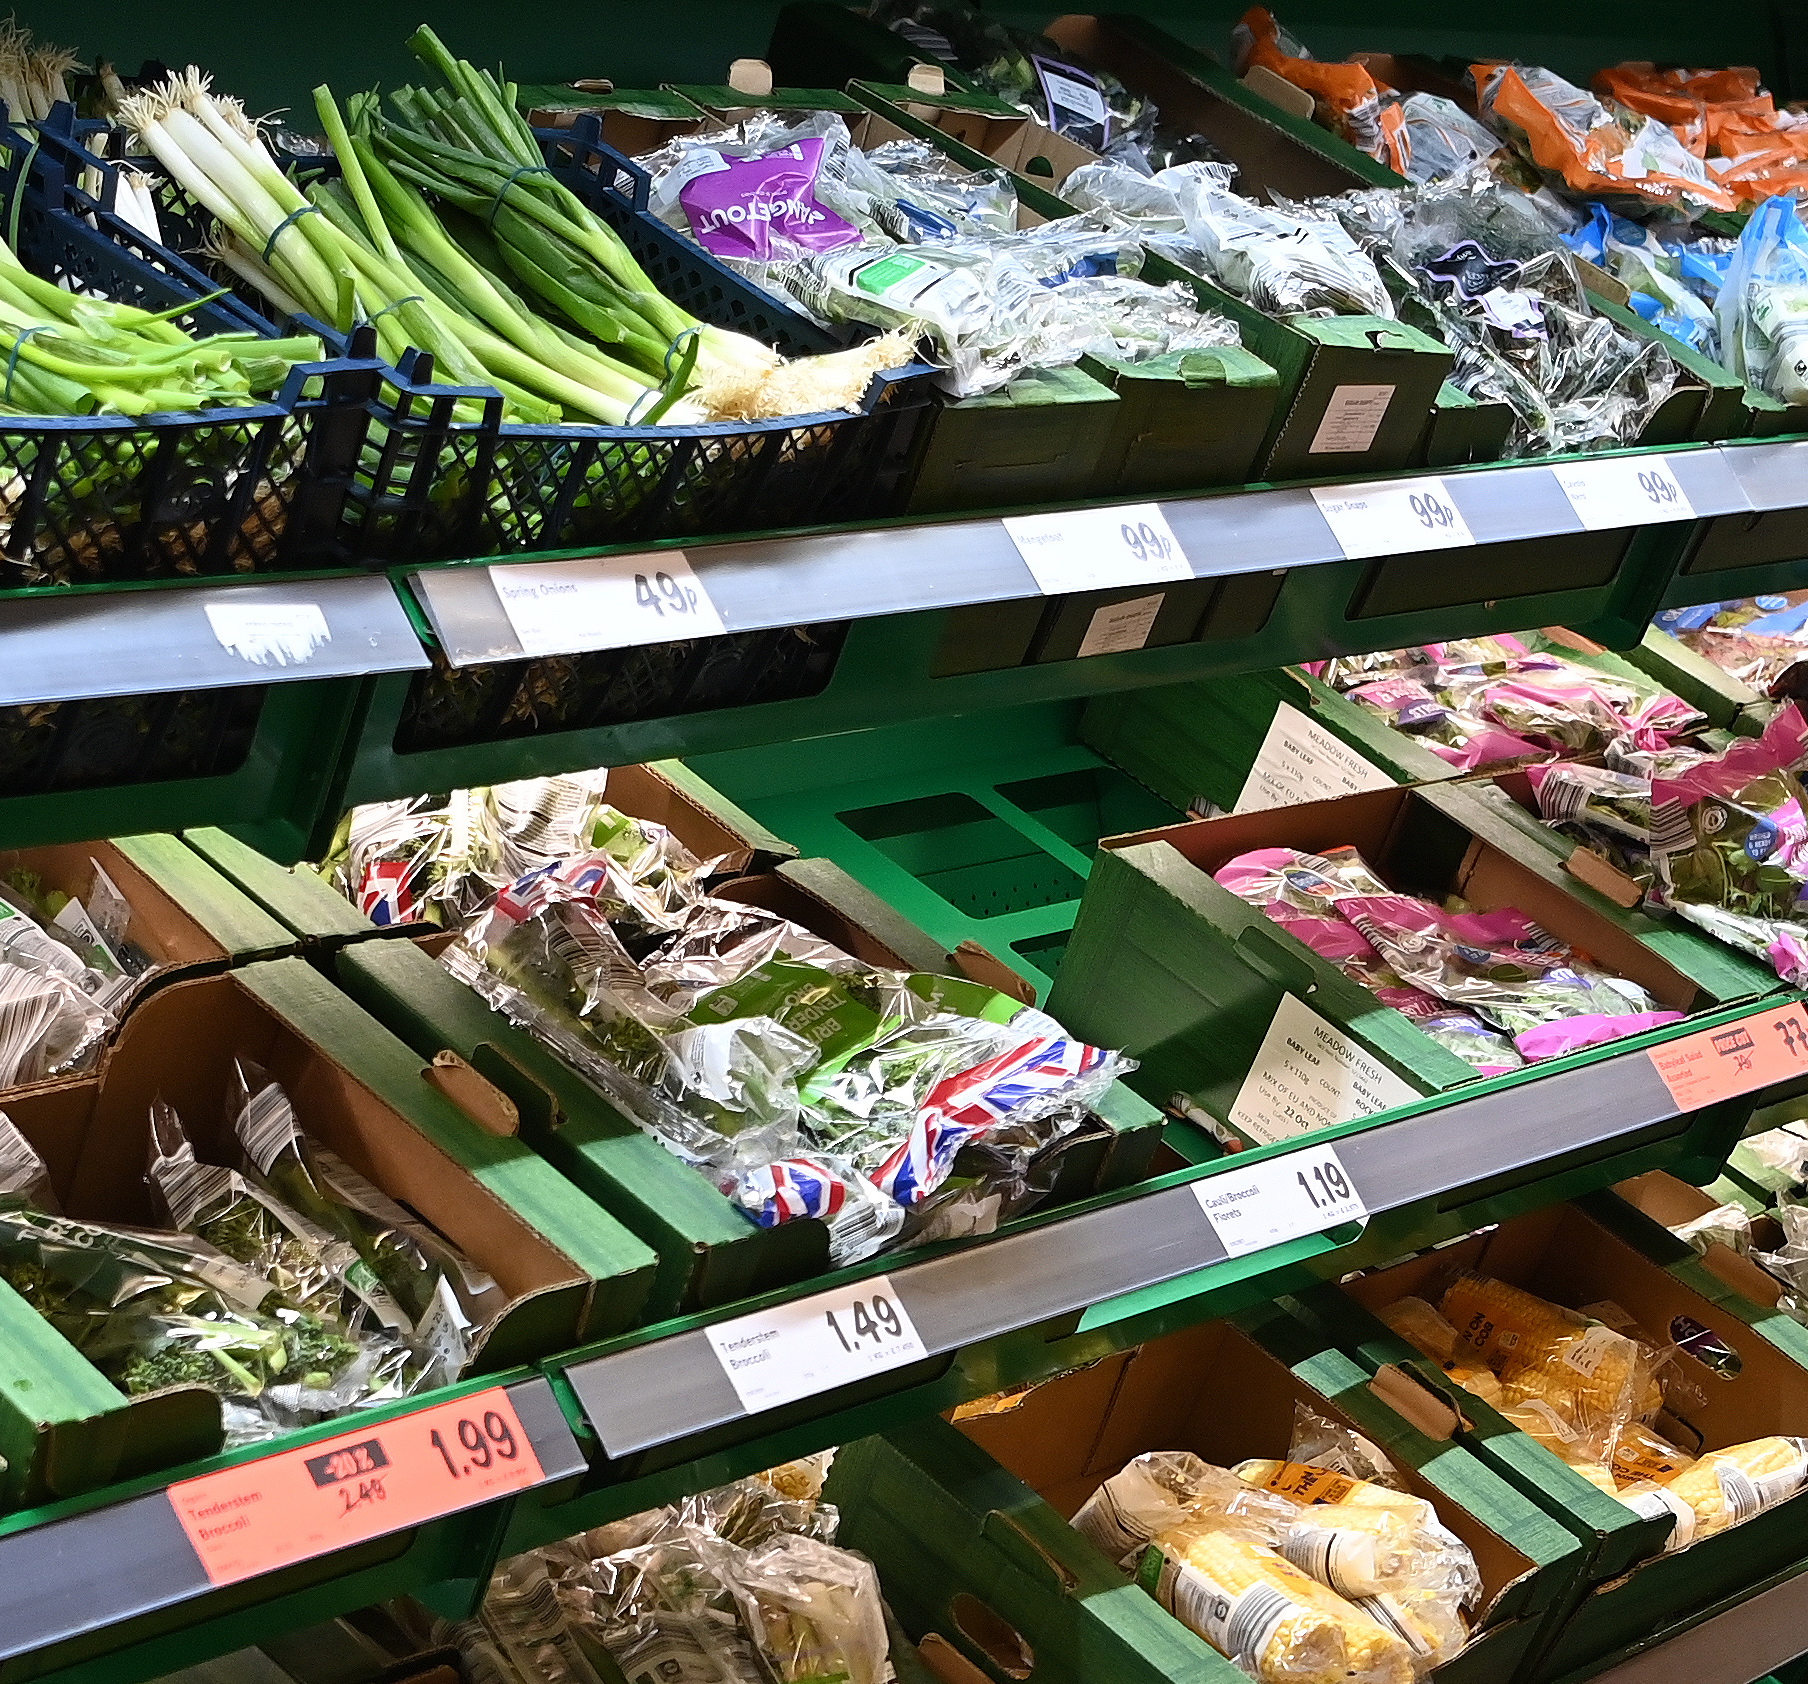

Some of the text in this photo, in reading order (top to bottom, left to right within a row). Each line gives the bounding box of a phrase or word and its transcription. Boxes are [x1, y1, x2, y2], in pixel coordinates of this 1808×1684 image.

[1638, 471, 1677, 503] 99p
[1409, 493, 1454, 528] 99p
[1121, 522, 1171, 561] 99p
[502, 582, 578, 601] Spring Onions
[634, 572, 697, 616] 49p
[1283, 740, 1301, 757] BABY
[1307, 730, 1370, 779] MEADOW FRESH
[1286, 1037, 1306, 1056] BABY
[1304, 1050, 1321, 1068] LEAF
[1352, 1081, 1372, 1101] BABY
[1314, 1025, 1384, 1085] MEADOW FRESH
[1262, 1070, 1316, 1114] MIX OF EU AND
[1294, 1066, 1311, 1086] 110g
[1258, 1084, 1310, 1131] Use 22 Oct
[1205, 1184, 1260, 1209] Cauli/Broccoli
[1297, 1162, 1349, 1208] 1.19
[1213, 1208, 1242, 1224] Florets
[826, 1295, 902, 1353] 1.49
[719, 1329, 780, 1355] Tenderstem
[731, 1348, 772, 1372] Broccoli
[431, 1411, 519, 1480] 1.99
[187, 1489, 262, 1522] Tenderstem
[199, 1515, 252, 1542] Broccoli
